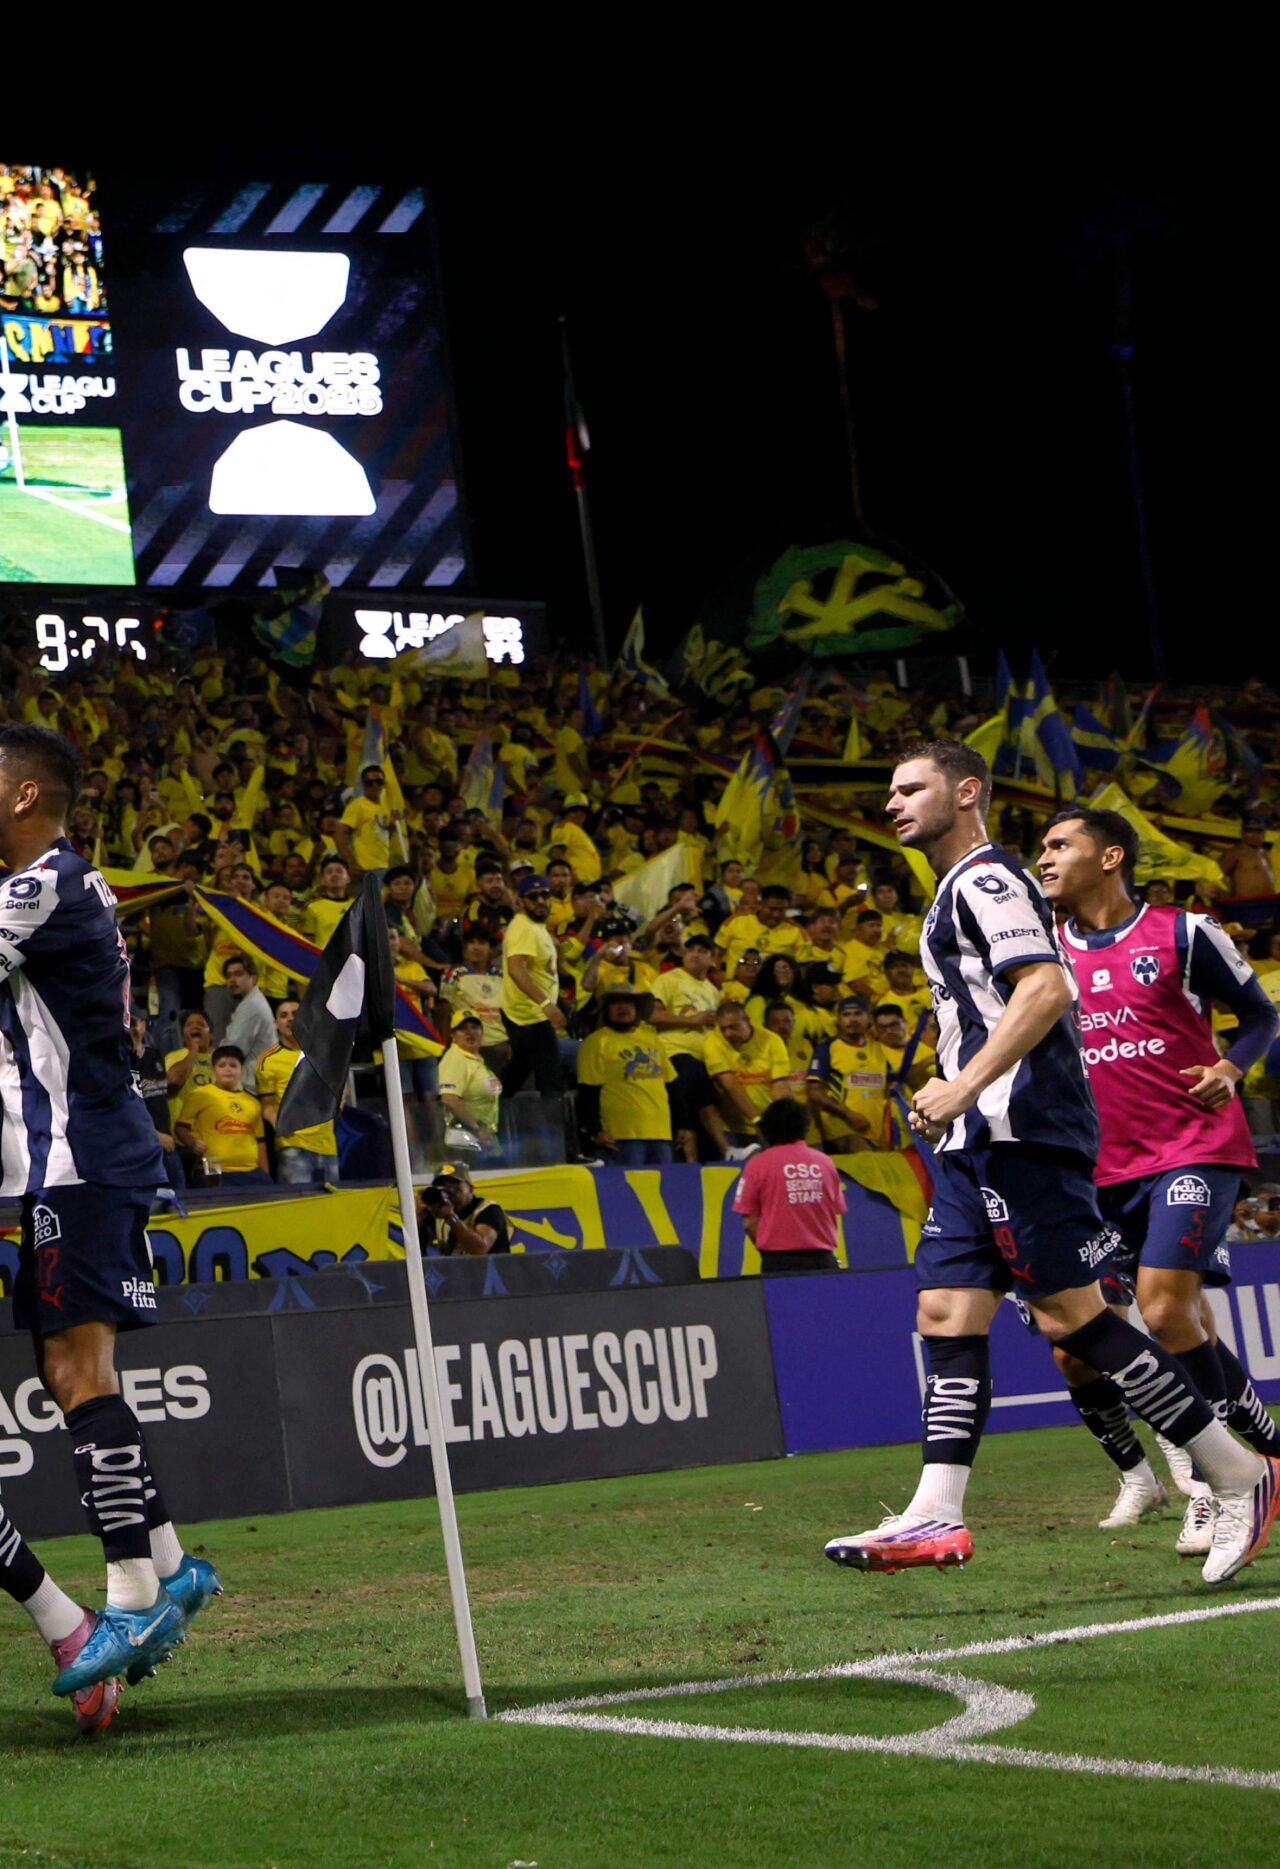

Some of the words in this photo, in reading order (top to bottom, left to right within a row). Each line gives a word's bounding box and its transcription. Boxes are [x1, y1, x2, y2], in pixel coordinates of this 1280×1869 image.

[176, 348, 381, 386] LEAGUES
[31, 396, 86, 414] CUP
[179, 381, 272, 413] CUP
[5, 899, 41, 910] Berel
[990, 928, 1041, 944] CREST
[1080, 1006, 1138, 1031] BBVA
[783, 1163, 823, 1179] CSC
[788, 1190, 824, 1204] STAFF
[1173, 1185, 1206, 1194] POLLO
[1173, 1193, 1205, 1202] LOCO
[352, 1325, 719, 1468] @LEAGUESCUP
